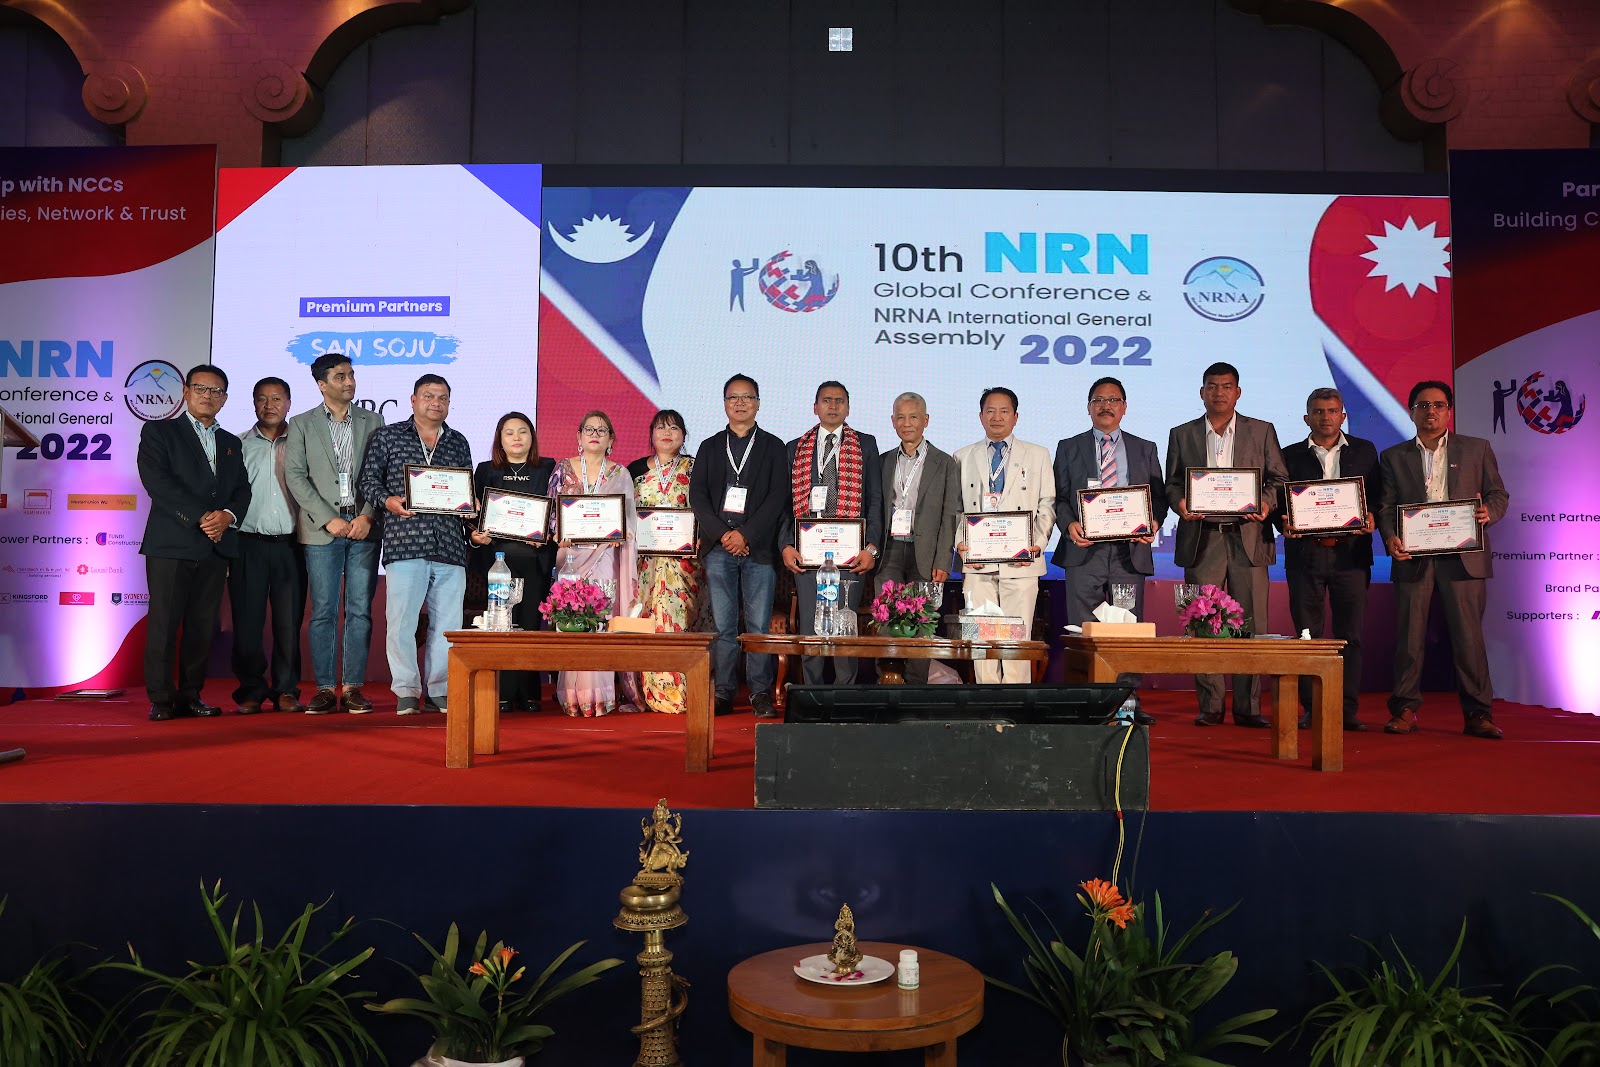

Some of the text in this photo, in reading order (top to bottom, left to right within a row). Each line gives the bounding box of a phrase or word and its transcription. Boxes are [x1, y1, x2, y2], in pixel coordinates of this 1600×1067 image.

[19, 176, 64, 192] with
[68, 176, 124, 193] NCCs
[37, 205, 115, 221] Network
[119, 206, 134, 221] &
[140, 206, 187, 221] Trust
[1493, 211, 1577, 231] Building
[873, 231, 1150, 275] 10th NRN
[873, 282, 1152, 302] Global Conference &
[1198, 291, 1249, 303] NRNA
[305, 299, 443, 313] Premium Partners
[873, 307, 1152, 327] NRNA International General
[874, 329, 1006, 350] Assembly
[310, 337, 436, 358] SAN SOJU
[1019, 334, 1152, 366] 2022
[0, 340, 114, 378] NRN
[103, 391, 114, 402] &
[135, 393, 174, 405] NRNA
[58, 412, 113, 425] General
[1521, 513, 1556, 522] Event
[32, 535, 83, 545] Partners
[1491, 551, 1546, 561] Premium
[1549, 551, 1594, 561] Partner
[1545, 584, 1581, 593] Brand
[1506, 611, 1573, 622] Supporters
